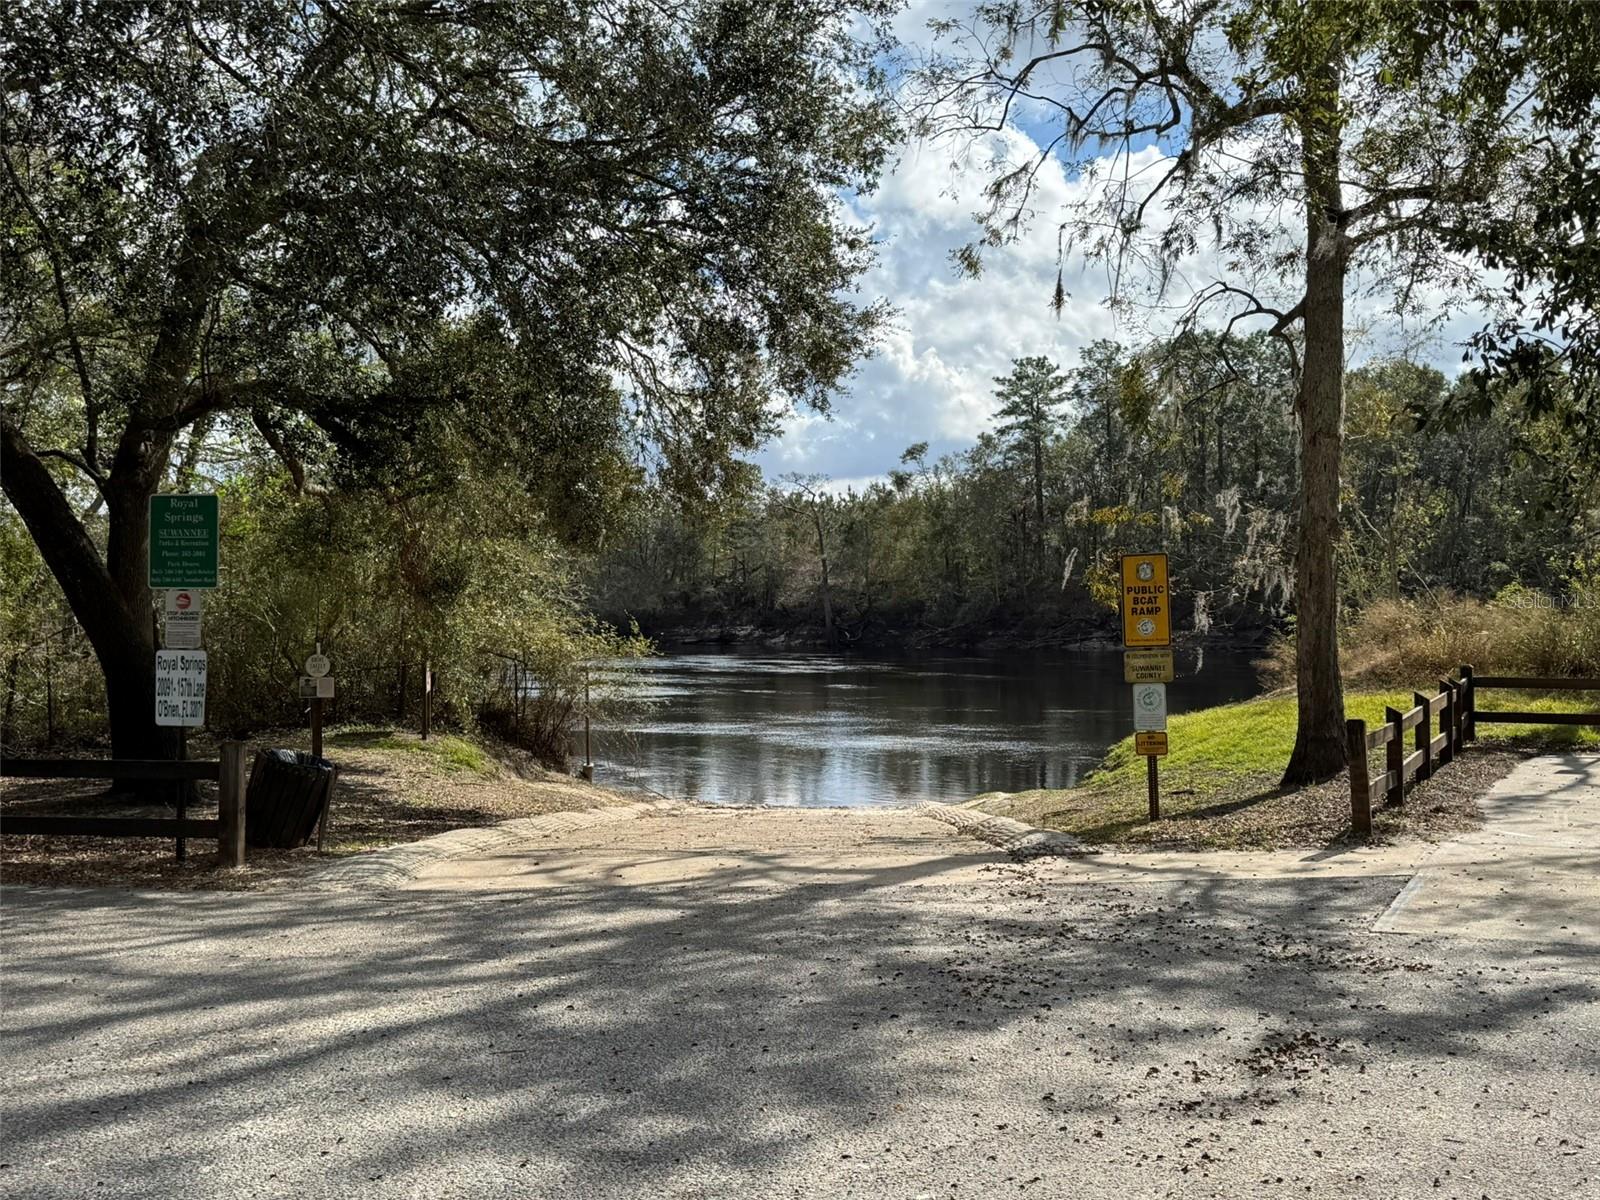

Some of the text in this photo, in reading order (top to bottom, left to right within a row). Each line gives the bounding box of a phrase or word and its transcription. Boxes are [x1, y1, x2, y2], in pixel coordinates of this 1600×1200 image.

[170, 498, 198, 510] Royal
[164, 512, 204, 524] Springs
[158, 528, 209, 537] SUWANNEE
[1126, 585, 1165, 595] PUBLIC
[1131, 606, 1161, 616] RAMP
[157, 655, 206, 675] Royal Springs
[1130, 664, 1166, 672] SUWANNEE
[1136, 671, 1162, 679] COUNTY
[177, 677, 193, 697] 157th
[193, 677, 205, 698] Lane
[181, 700, 189, 718] FL
